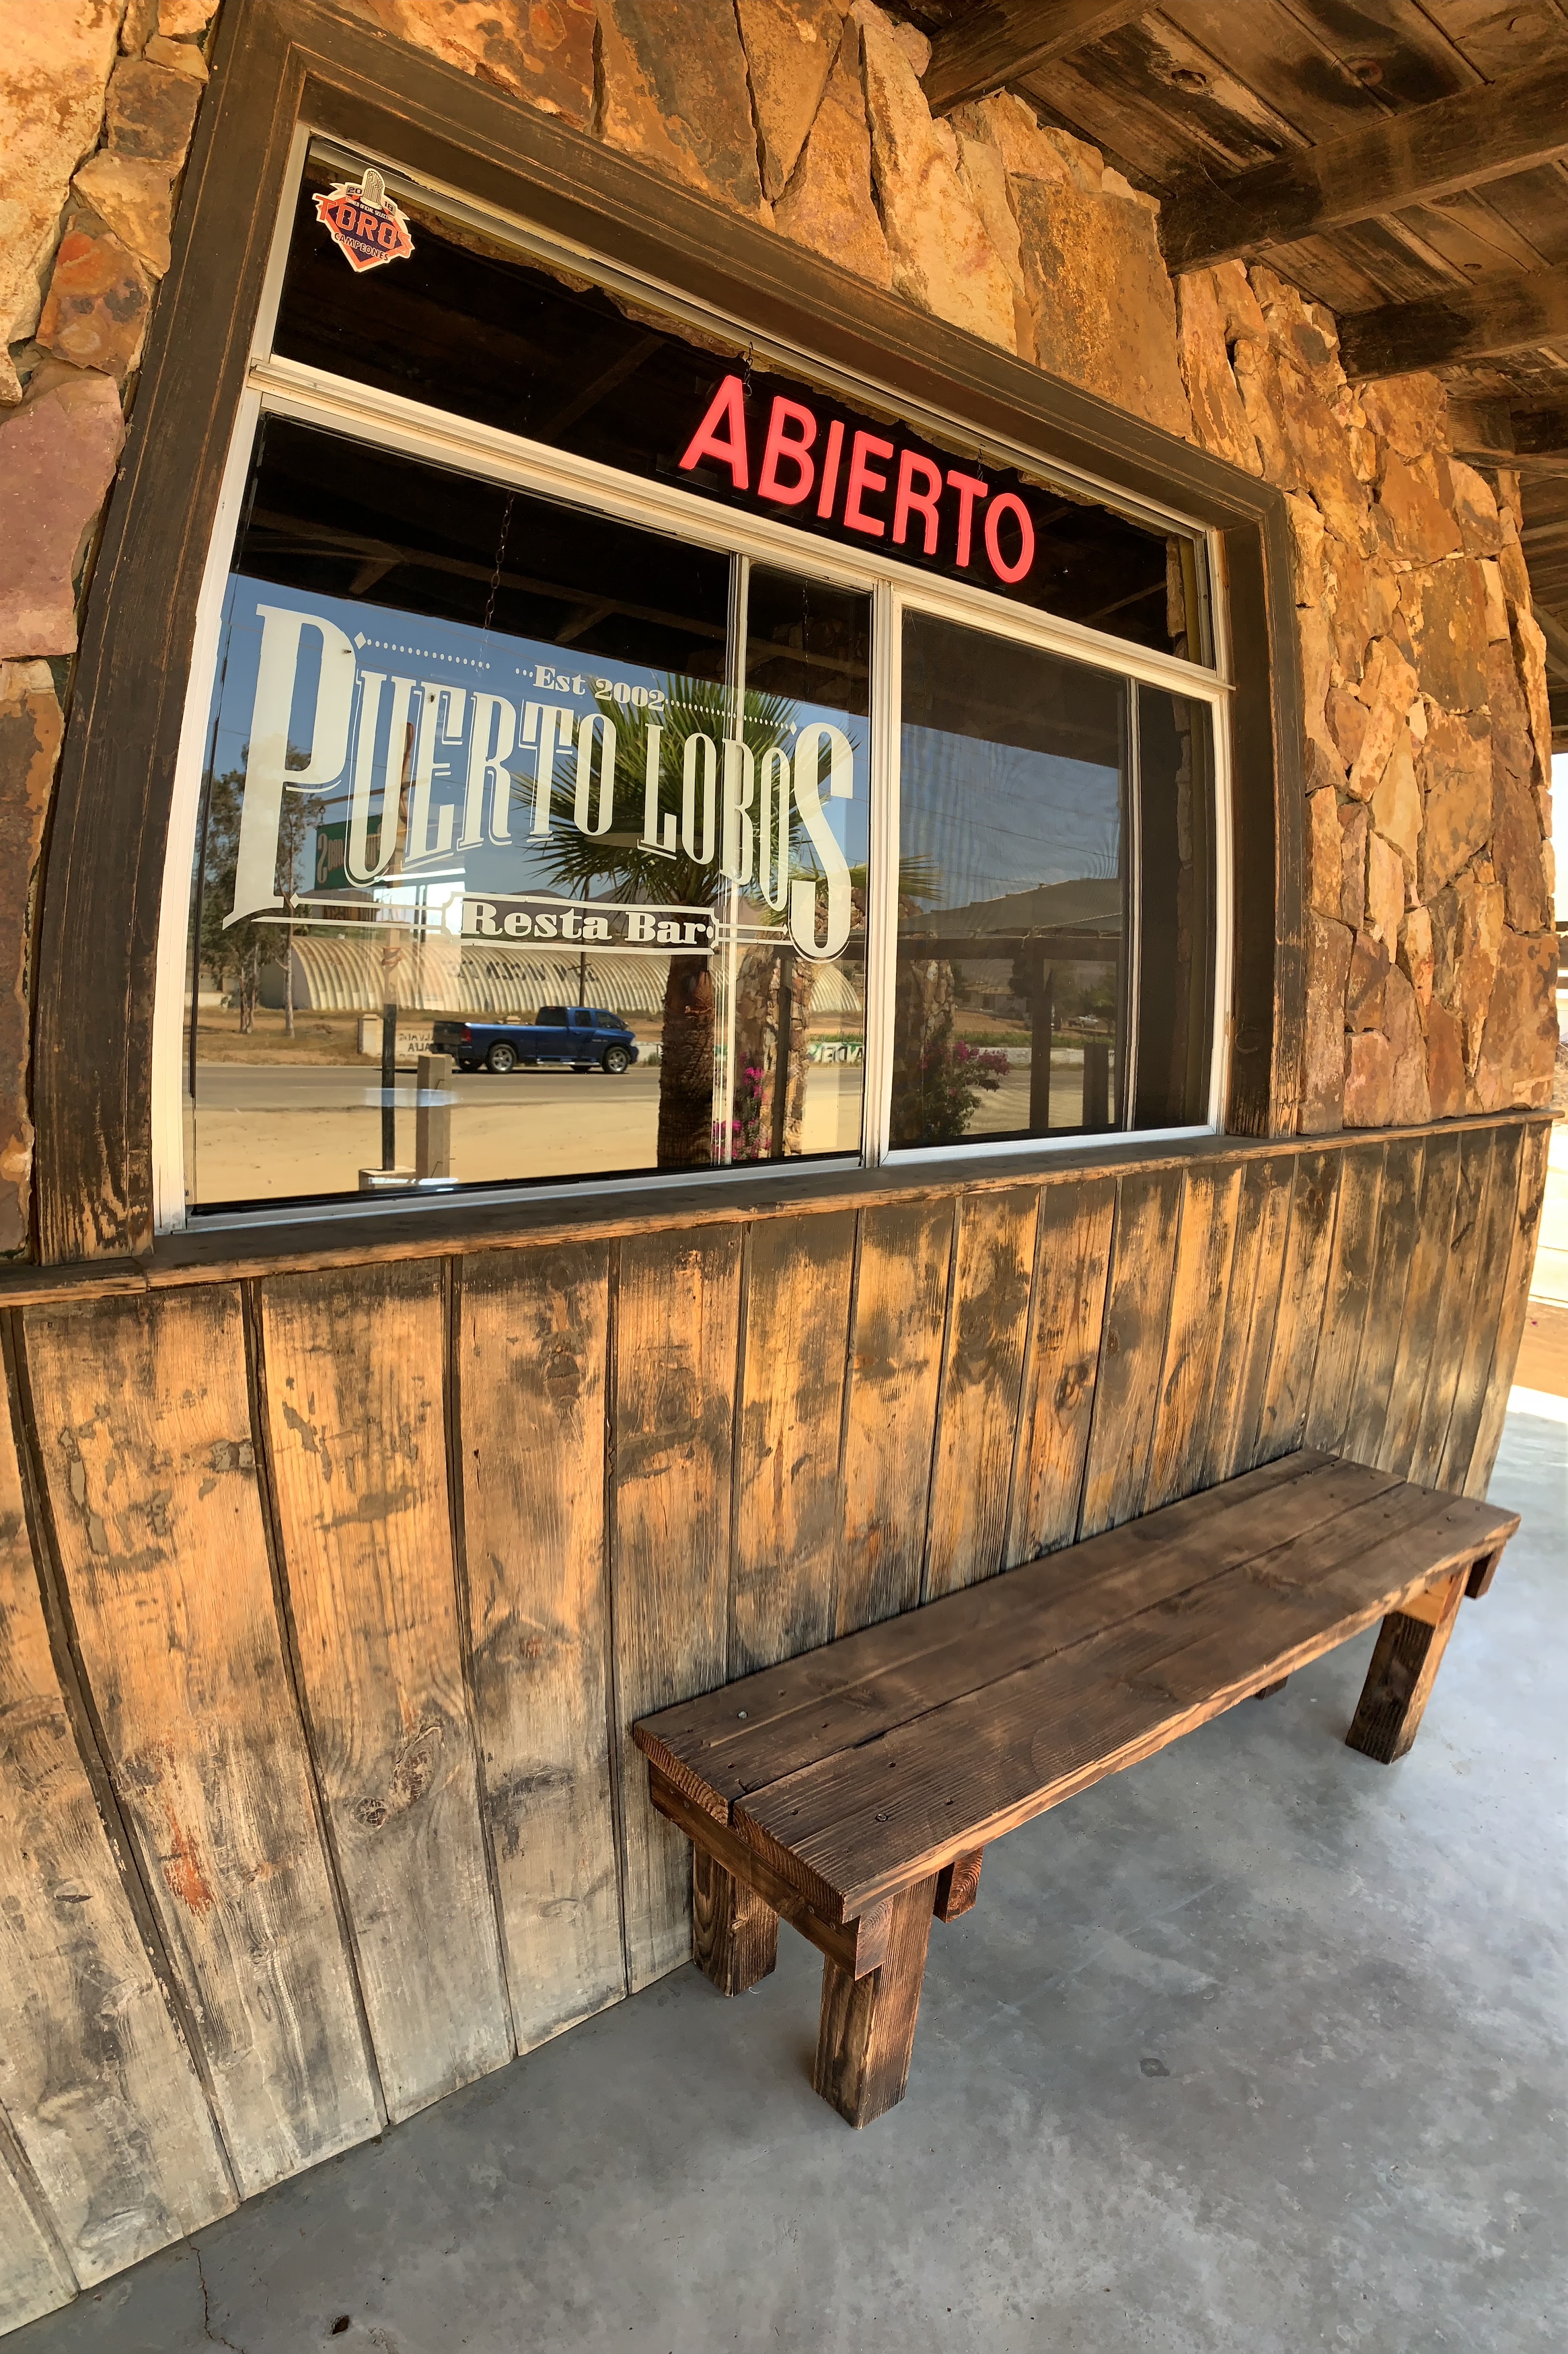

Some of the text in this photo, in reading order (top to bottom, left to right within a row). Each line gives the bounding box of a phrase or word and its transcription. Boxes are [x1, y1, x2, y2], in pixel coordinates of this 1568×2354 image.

[315, 195, 412, 257] TOROS
[384, 201, 393, 211] 18
[334, 233, 389, 261] CAMPEONES
[678, 375, 1035, 584] ABIERTO
[533, 665, 666, 712] Est 2002
[222, 604, 854, 963] PUERTO LOBOS
[459, 901, 707, 945] Resta Bar
